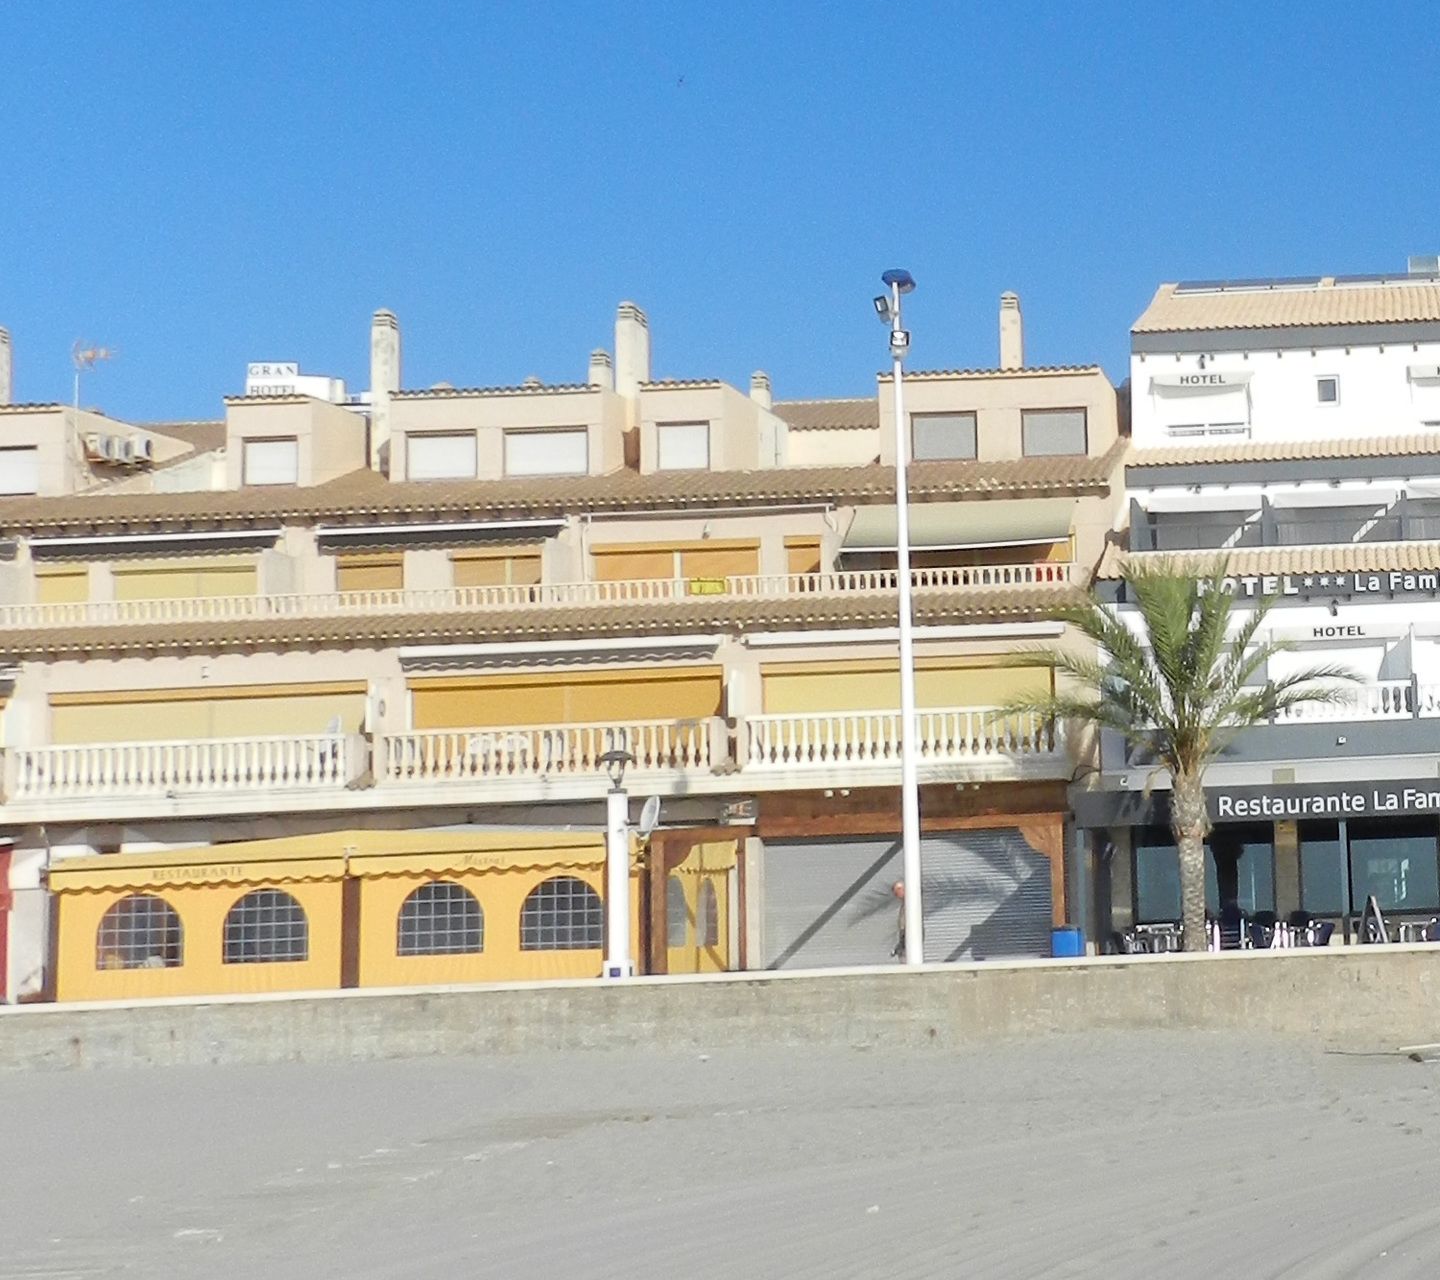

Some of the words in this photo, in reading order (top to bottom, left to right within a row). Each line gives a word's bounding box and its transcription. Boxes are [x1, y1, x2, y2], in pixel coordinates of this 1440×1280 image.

[1180, 374, 1226, 384] HOTEL
[1354, 572, 1381, 592] La
[1313, 625, 1366, 637] HOTEL
[1219, 792, 1366, 817] Restaurante
[1373, 790, 1399, 811] La
